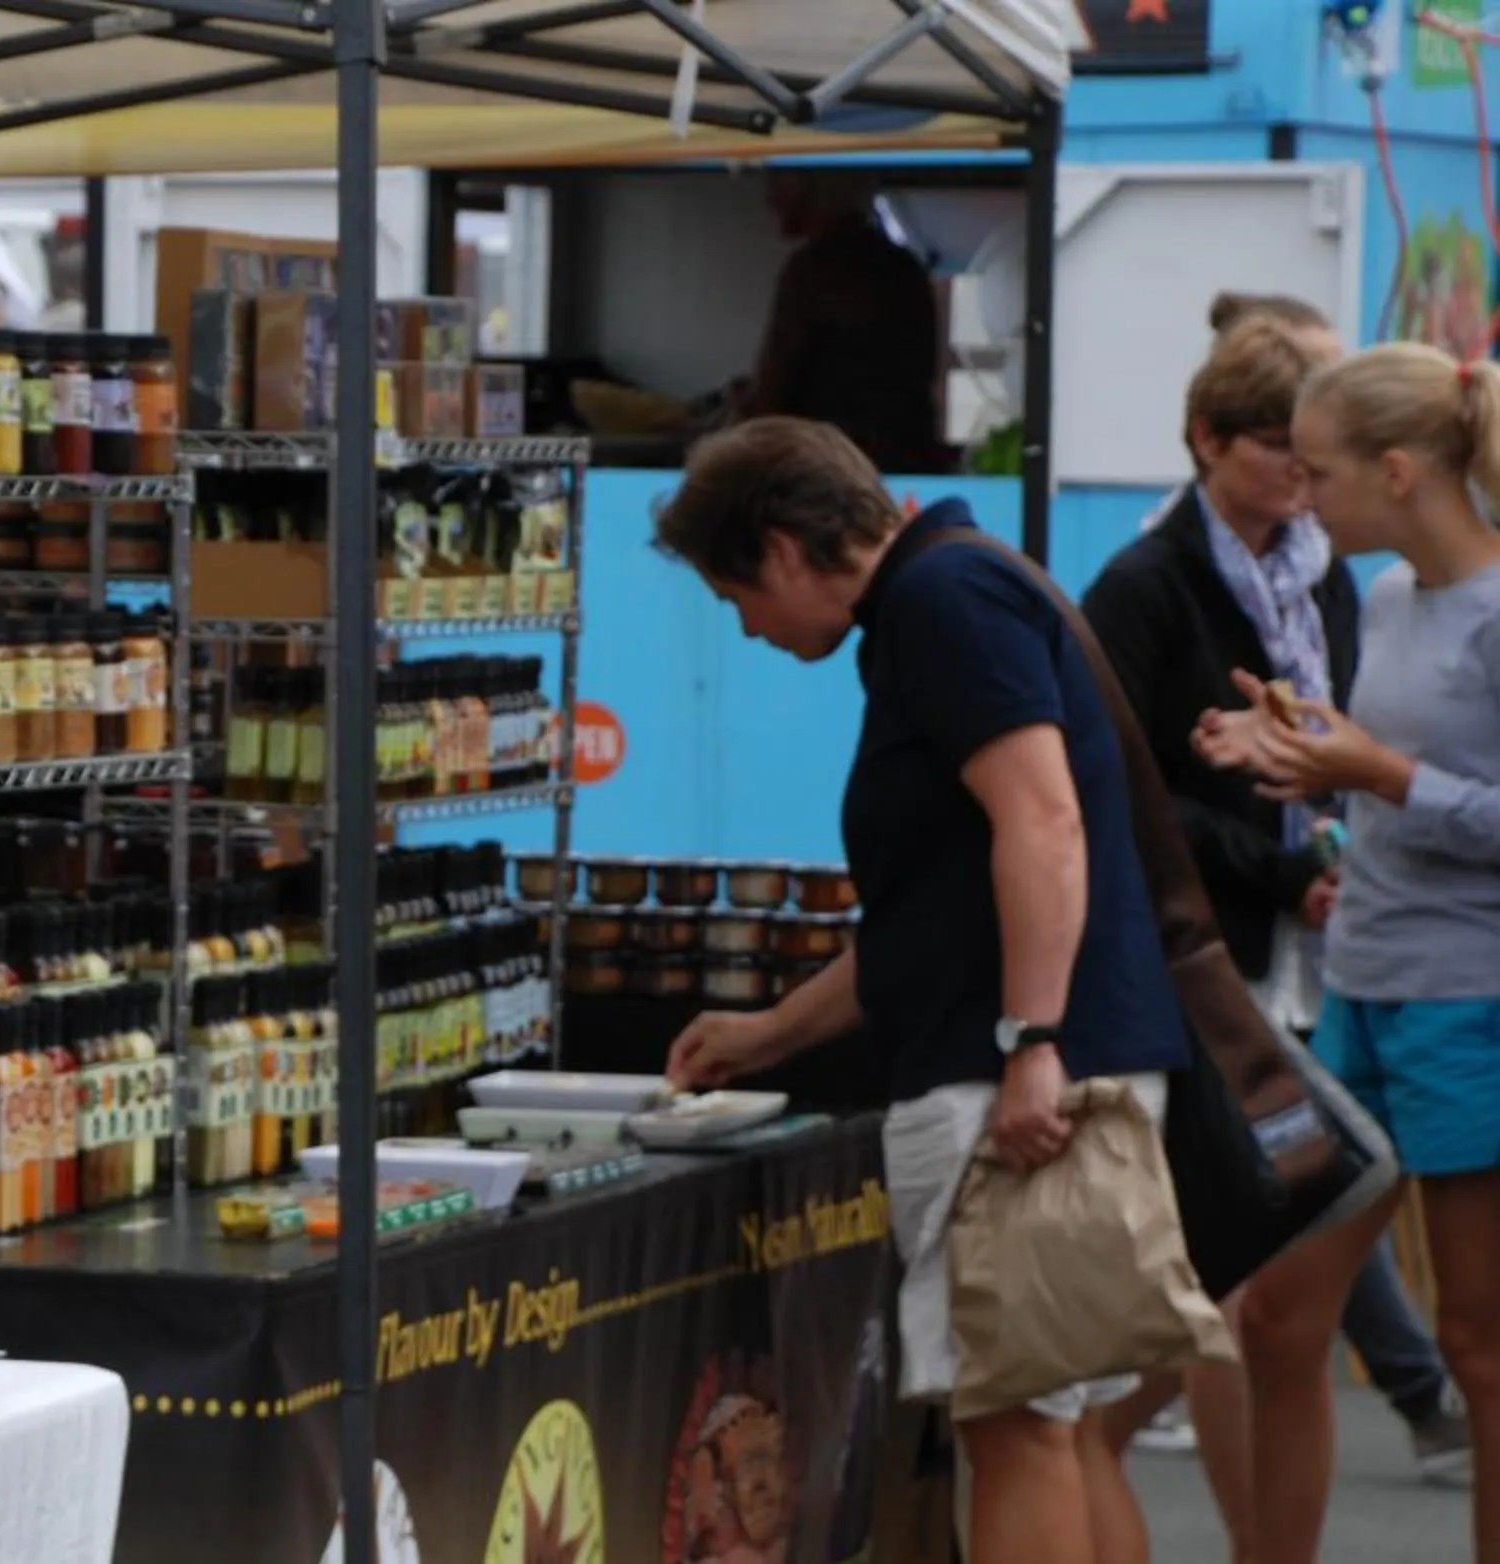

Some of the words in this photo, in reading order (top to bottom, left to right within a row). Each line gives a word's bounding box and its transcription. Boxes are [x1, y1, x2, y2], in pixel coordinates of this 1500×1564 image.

[374, 1310, 464, 1385] Flavour
[465, 1285, 500, 1368] by
[503, 1266, 579, 1351] Design
